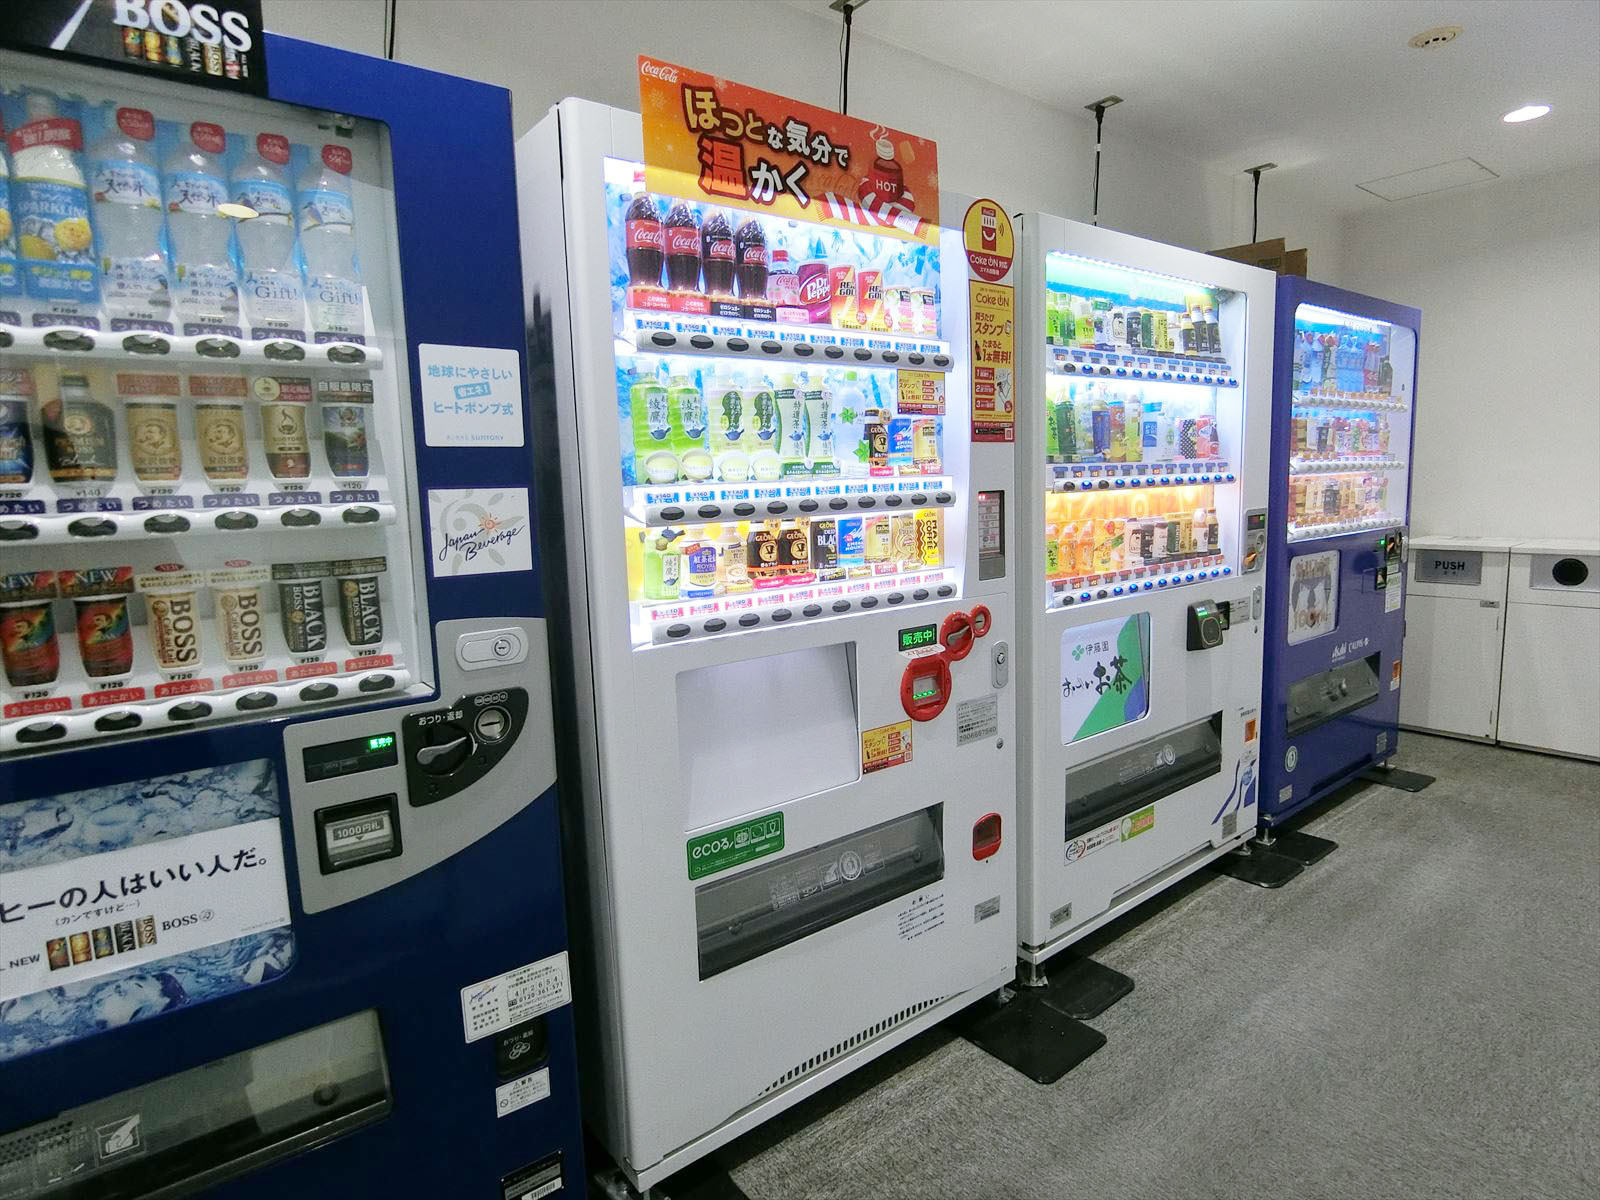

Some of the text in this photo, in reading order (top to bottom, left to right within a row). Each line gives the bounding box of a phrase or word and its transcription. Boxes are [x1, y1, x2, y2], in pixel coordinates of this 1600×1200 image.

[113, 0, 252, 52] BOSS
[683, 85, 849, 168] ほっとな気分で
[699, 136, 810, 208] 温かく
[875, 179, 897, 193] HOT
[970, 254, 988, 266] Coke
[816, 277, 828, 288] Dr
[255, 285, 299, 301] Gift!
[319, 291, 360, 306] Gift!
[975, 292, 1010, 307] Coke ON
[975, 312, 994, 322] 買うたび
[974, 321, 1005, 337] スタンプ
[982, 339, 1002, 350] たまると
[427, 363, 513, 381] 地球にやさしい
[318, 381, 373, 393] 自販機限定
[433, 401, 514, 416] ヒートポンプ式
[138, 499, 189, 510] つめたい
[207, 497, 256, 507] つめたい
[273, 494, 318, 504] つめたい
[334, 492, 376, 502] つめたい
[459, 524, 526, 562] Beverage
[925, 521, 933, 550] COFFEE
[1434, 560, 1465, 570] PUSH
[0, 573, 38, 589] NEW
[75, 569, 118, 585] NEW
[292, 586, 303, 610] BOSS
[303, 582, 326, 650] BLACK
[358, 577, 376, 641] BLACK
[170, 599, 198, 663] BOSS
[237, 594, 263, 656] BOSS
[902, 630, 934, 646] 販売中
[1085, 640, 1110, 656] 伊藤園
[300, 656, 320, 664] ¥120
[350, 658, 390, 670] あたたかい
[238, 664, 259, 672] ¥120
[291, 665, 334, 678] あたたかい
[169, 673, 193, 681] ¥120
[227, 673, 273, 687] あたたかい
[100, 681, 124, 689] ¥120
[159, 682, 210, 696] あたたかい
[24, 691, 49, 699] ¥120
[88, 691, 141, 705] あたたかい
[10, 702, 67, 715] あたたかい
[418, 711, 463, 726] おつり・返却
[369, 736, 393, 750] 販売中
[336, 820, 381, 839] 1000円札
[0, 847, 268, 924] ヒーの人はいい人だ。
[161, 913, 199, 932] BOSS
[9, 953, 41, 969] NEW
